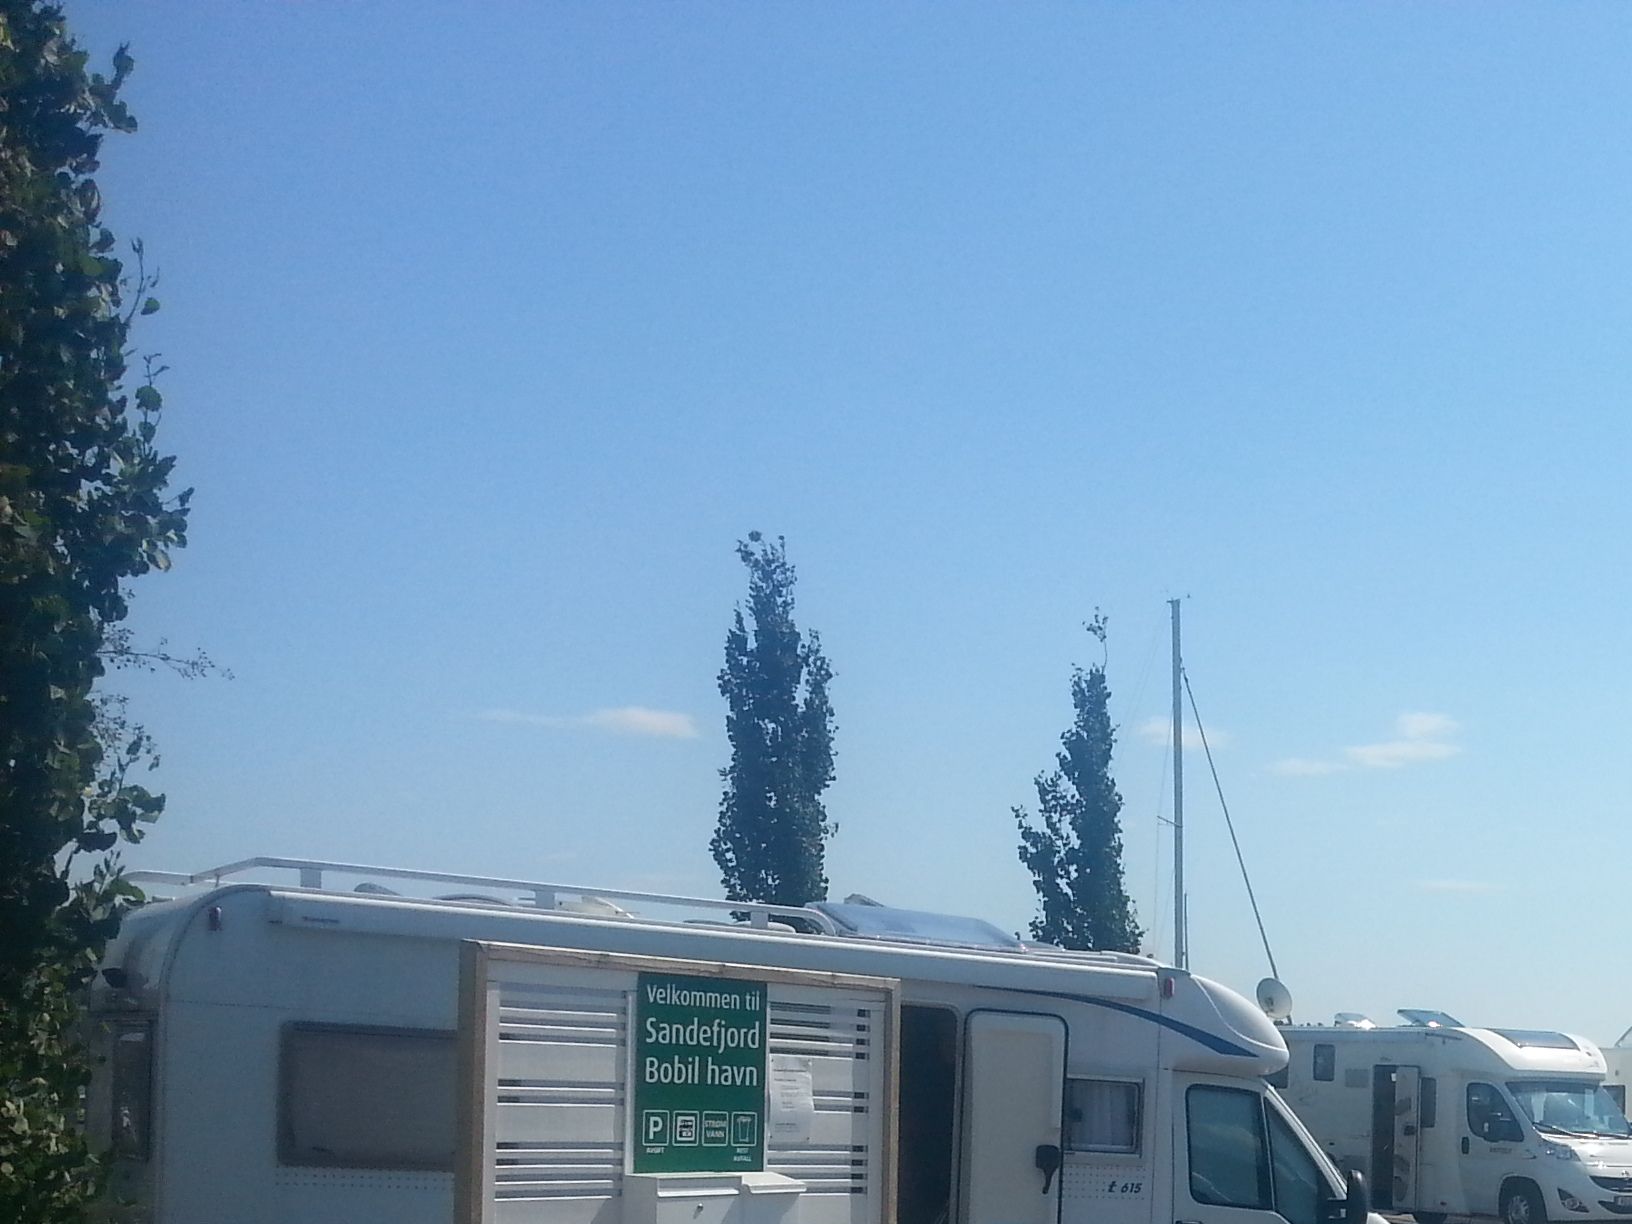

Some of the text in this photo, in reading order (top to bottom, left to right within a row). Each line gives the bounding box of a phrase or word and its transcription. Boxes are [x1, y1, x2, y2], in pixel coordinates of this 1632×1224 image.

[646, 983, 760, 1011] Velkommen til
[645, 1017, 760, 1054] Sandefjord
[645, 1055, 758, 1087] Bobil havn
[649, 1116, 663, 1140] P
[706, 1130, 725, 1138] VANN
[1120, 1182, 1143, 1194] 615
